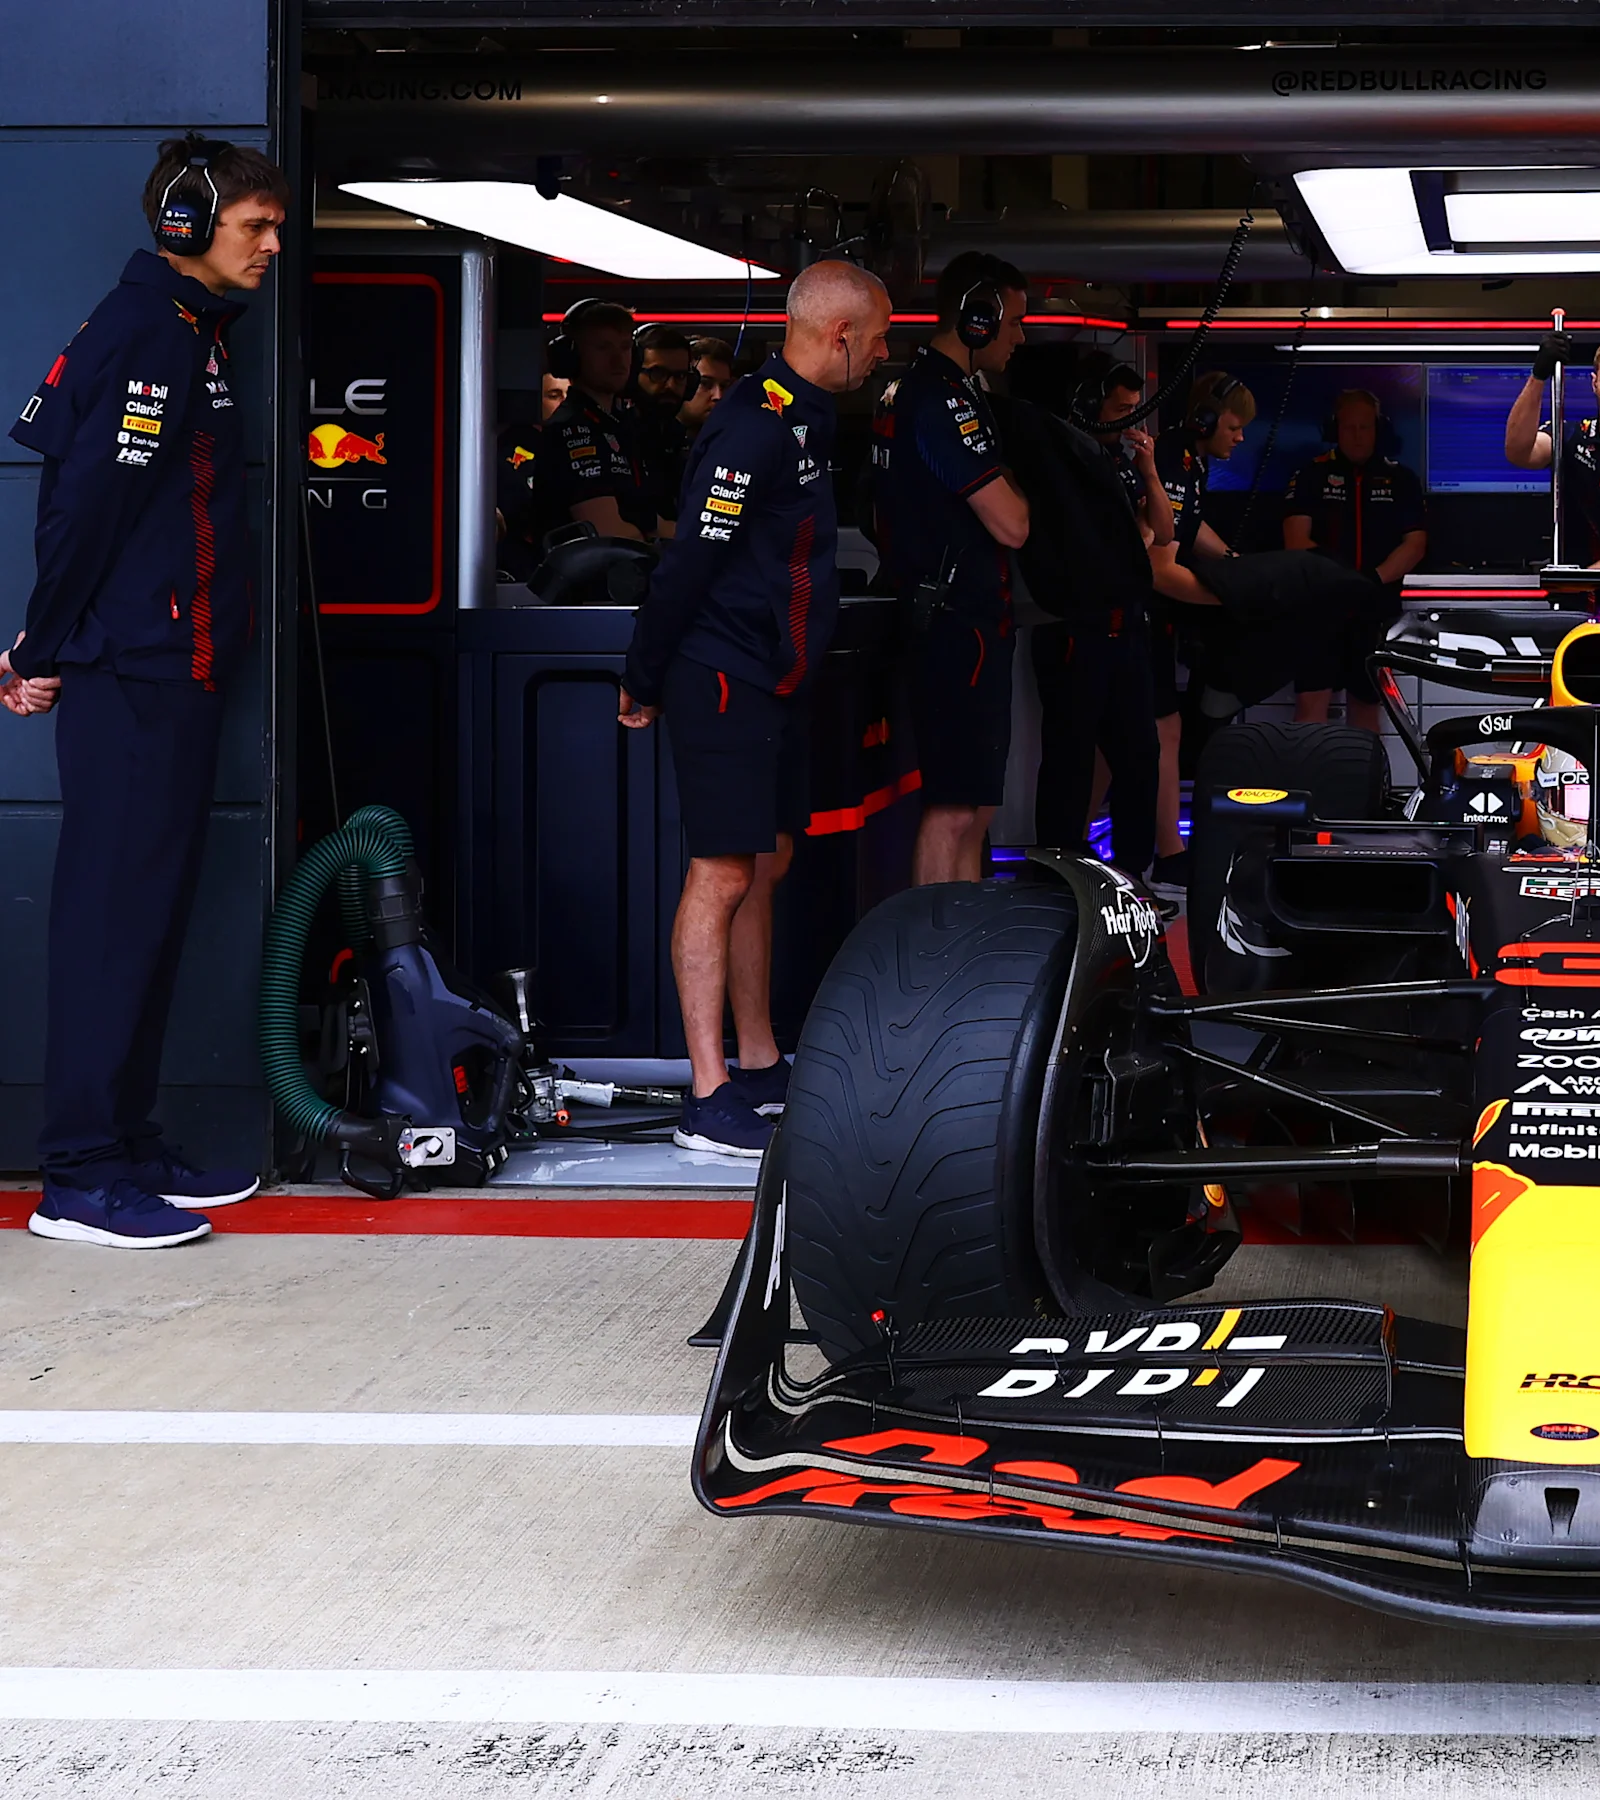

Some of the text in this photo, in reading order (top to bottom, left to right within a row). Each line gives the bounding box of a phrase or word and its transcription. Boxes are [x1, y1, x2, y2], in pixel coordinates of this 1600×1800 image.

[1271, 70, 1547, 97] @REDBULLRACING
[127, 380, 169, 400] Mobil
[125, 400, 164, 417] Claro
[714, 465, 751, 486] Mobil
[710, 485, 746, 500] Claro
[1493, 715, 1514, 732] Sui
[1242, 790, 1281, 798] RAUCH
[1463, 812, 1509, 825] inter.mx
[1130, 901, 1160, 938] Rock
[1522, 1008, 1585, 1019] Cash
